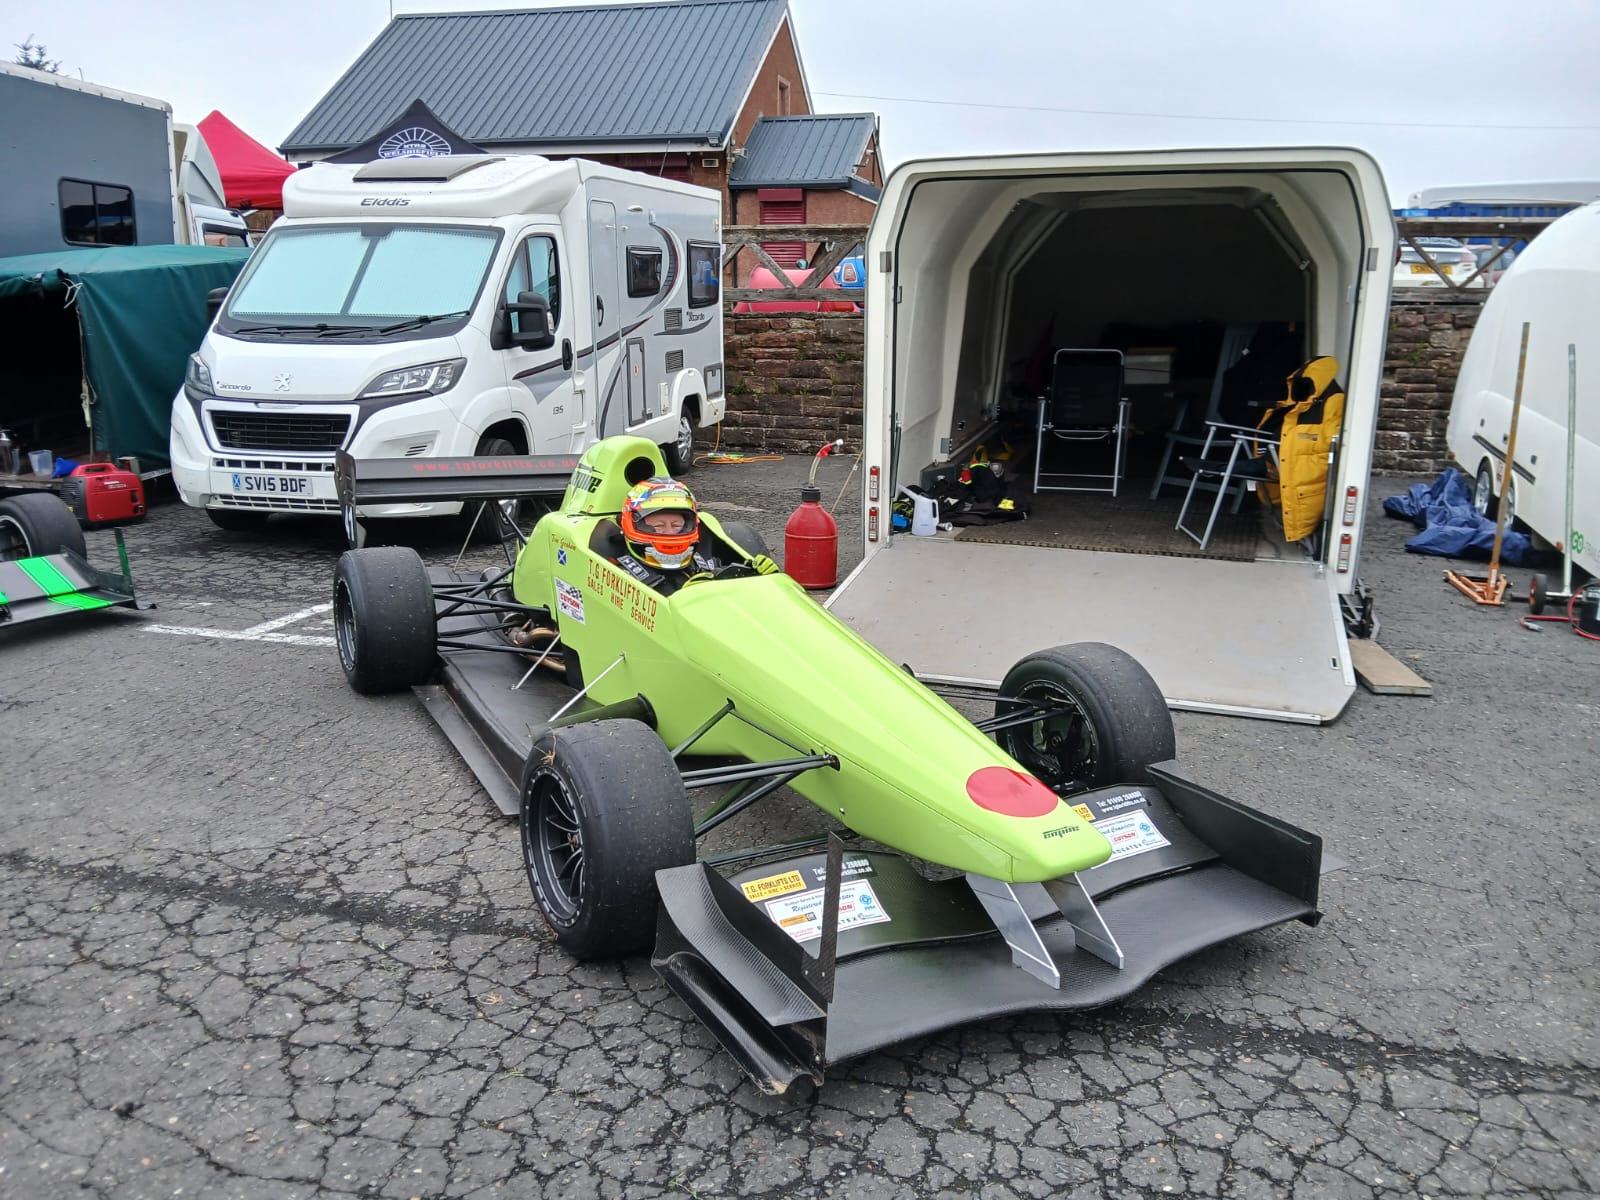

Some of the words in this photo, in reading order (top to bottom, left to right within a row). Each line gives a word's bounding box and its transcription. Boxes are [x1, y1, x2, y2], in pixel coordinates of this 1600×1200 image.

[360, 197, 411, 206] Elddis
[244, 476, 276, 492] SV15
[279, 478, 308, 493] BDF
[601, 567, 641, 607] FORKLIFTS
[642, 593, 657, 618] LTD
[587, 575, 604, 596] SALES
[610, 591, 624, 610] HIRE
[630, 606, 655, 633] SERVICE
[1043, 825, 1080, 839] empire
[758, 877, 788, 890] FORKLIFTS
[788, 874, 801, 883] LTD
[783, 882, 802, 891] SERVICE
